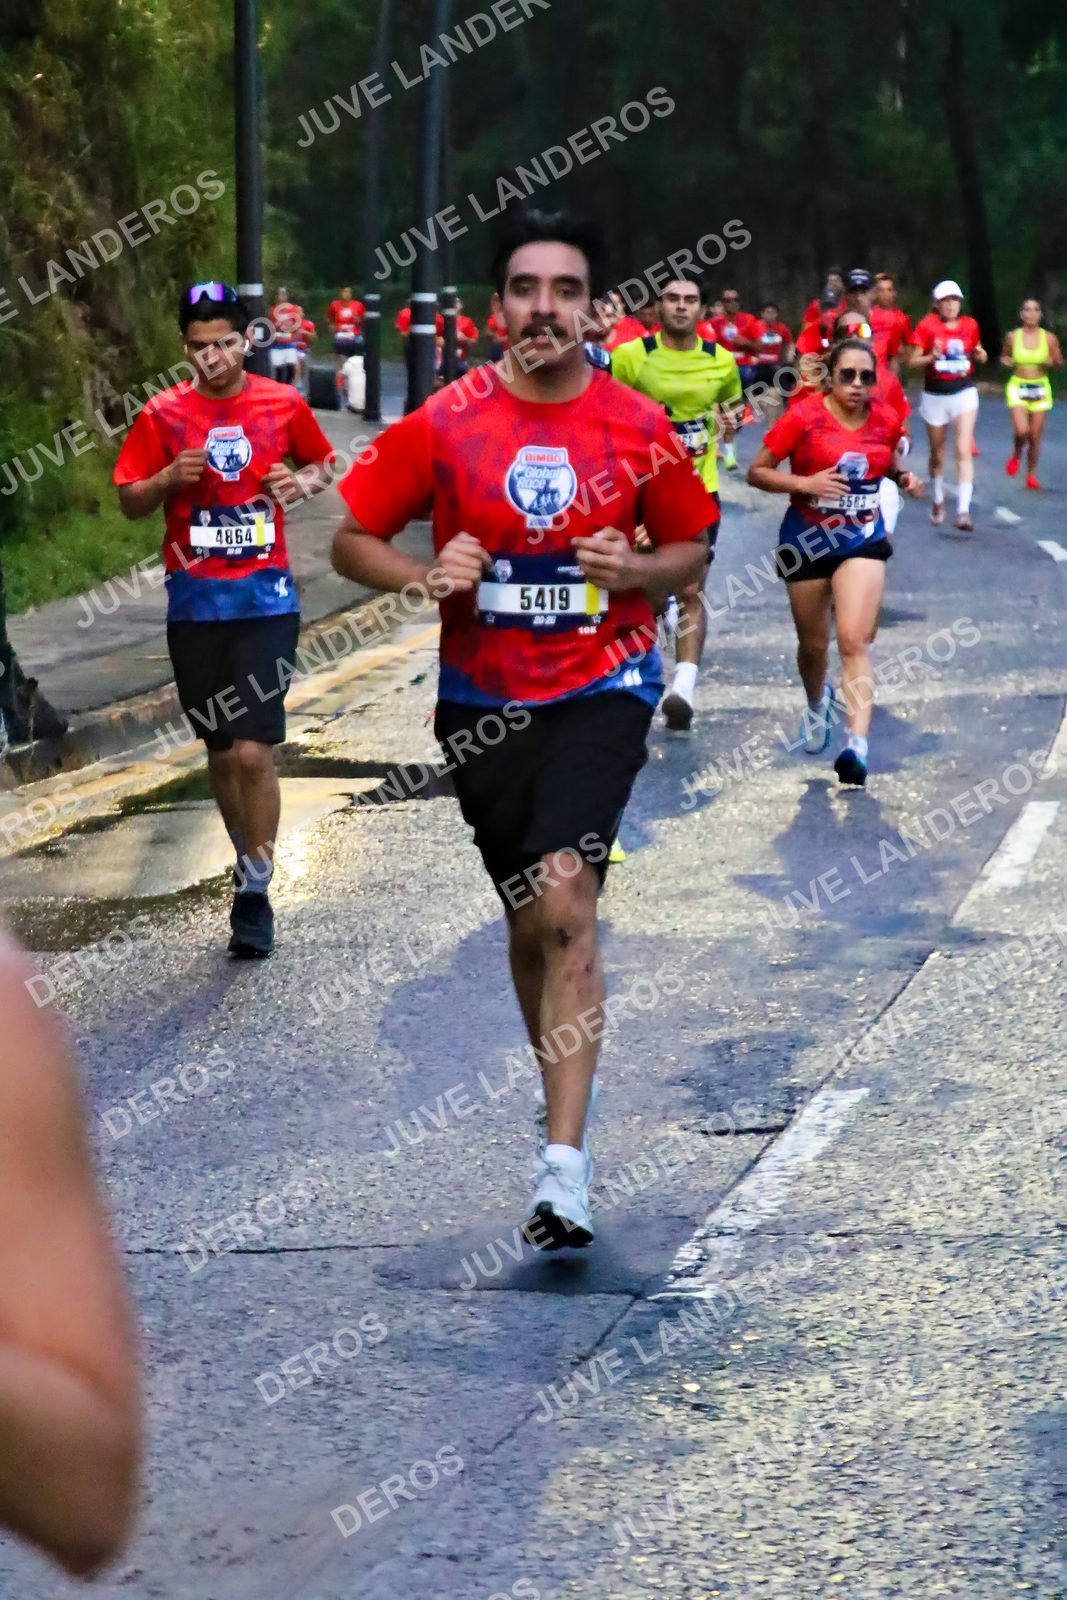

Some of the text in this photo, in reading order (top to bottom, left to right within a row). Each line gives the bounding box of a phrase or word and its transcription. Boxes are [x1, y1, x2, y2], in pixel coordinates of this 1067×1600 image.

[525, 453, 561, 463] BIMBO
[524, 466, 561, 478] Global
[517, 477, 546, 489] Race
[215, 528, 253, 545] 4864
[520, 586, 570, 610] 5419
